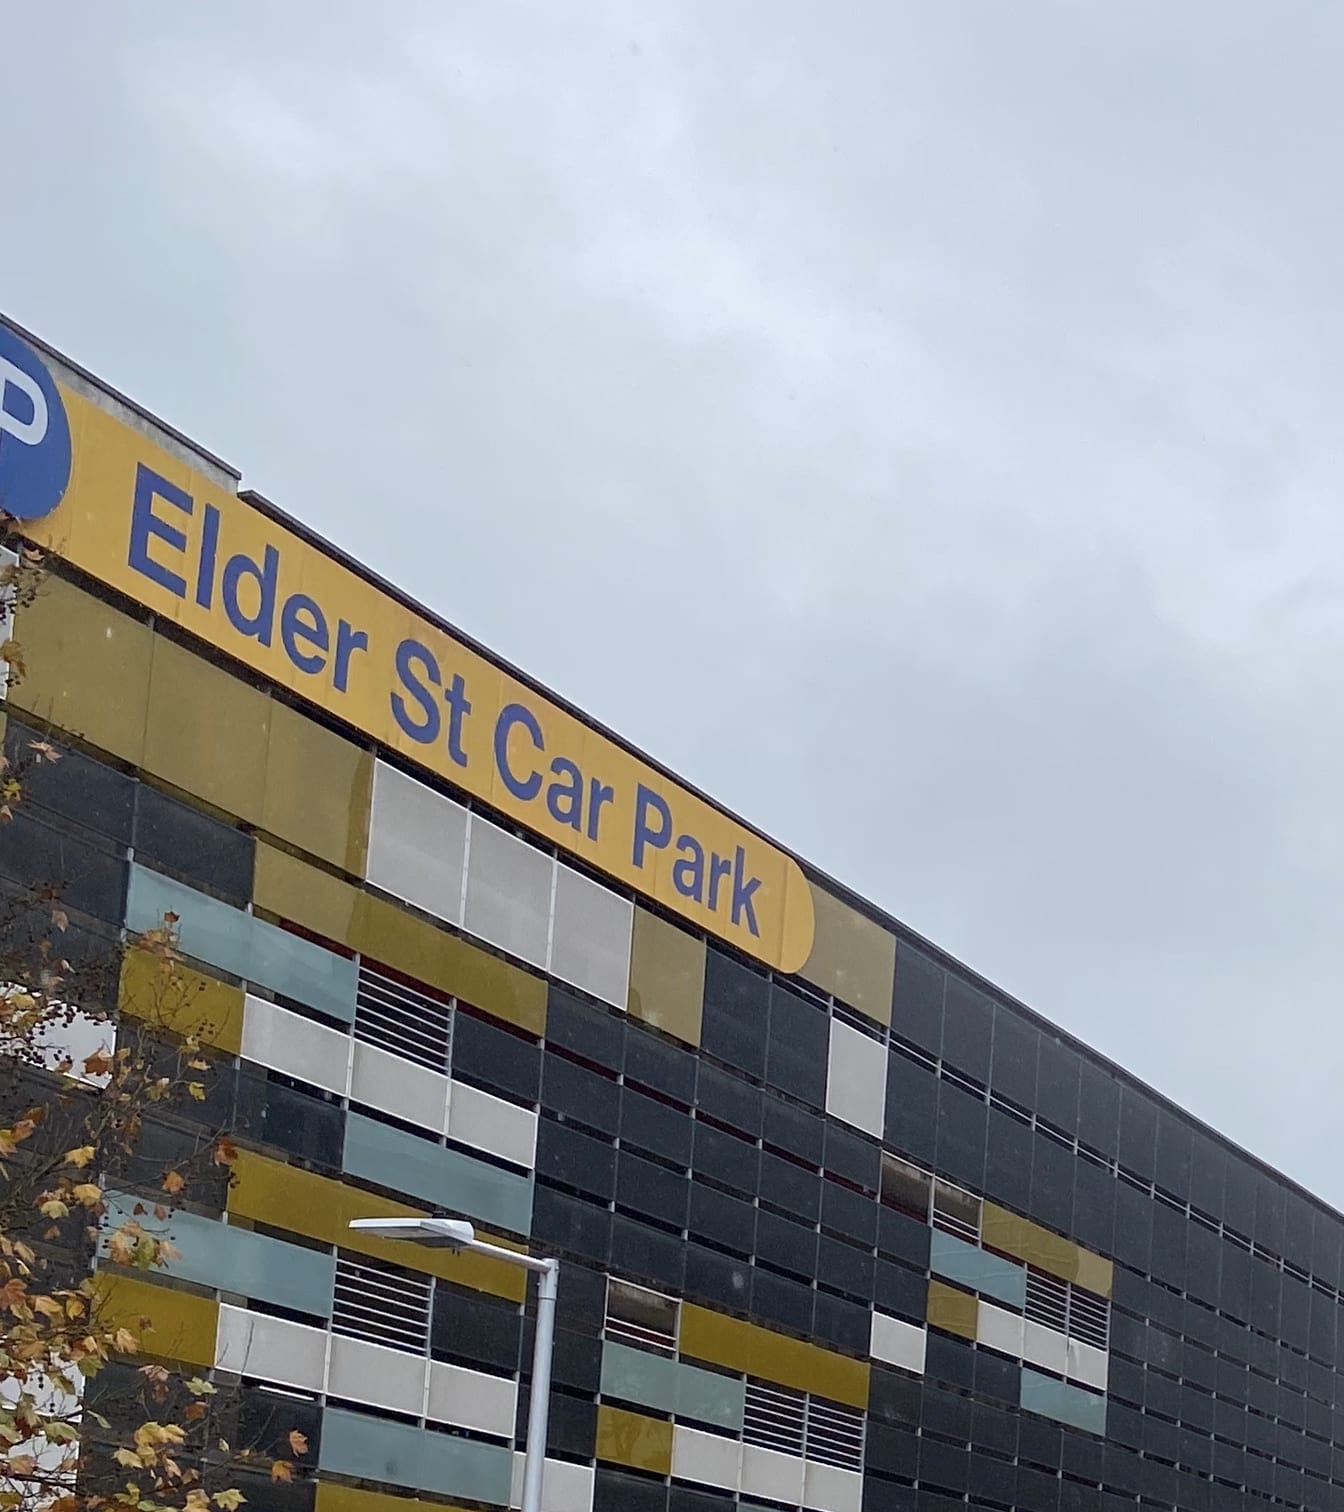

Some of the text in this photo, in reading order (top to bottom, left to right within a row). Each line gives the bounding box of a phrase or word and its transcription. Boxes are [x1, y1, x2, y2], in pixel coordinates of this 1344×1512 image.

[0, 355, 49, 446] P
[128, 462, 762, 937] Elder St Car Park
